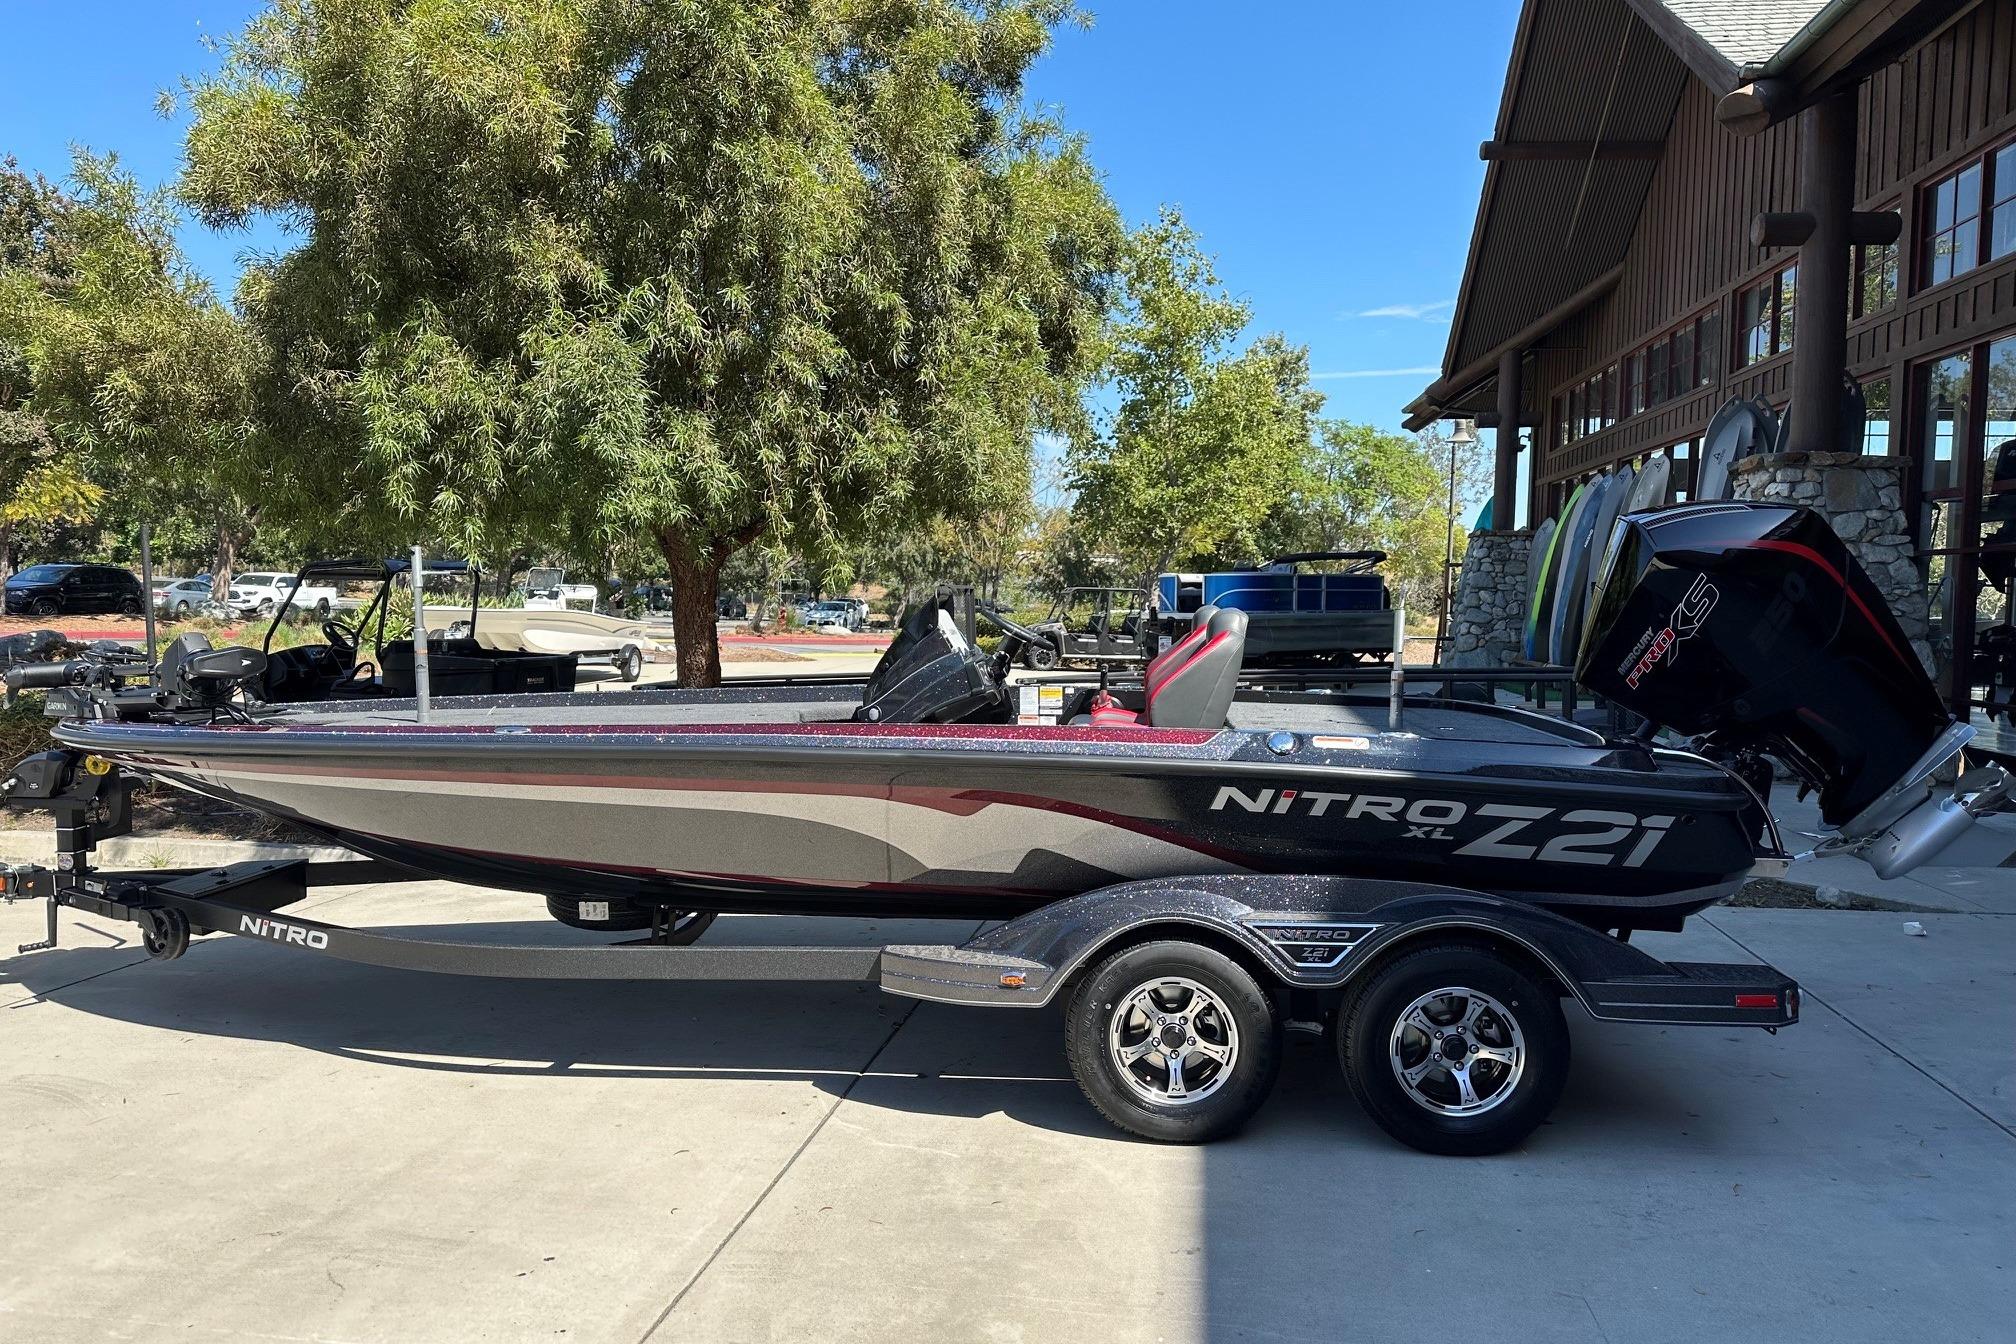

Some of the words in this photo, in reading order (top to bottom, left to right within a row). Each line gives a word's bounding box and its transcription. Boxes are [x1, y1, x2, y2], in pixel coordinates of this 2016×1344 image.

[1618, 626, 1655, 675] MERCURY
[46, 702, 67, 711] GARMIN
[1400, 825, 1454, 840] XL
